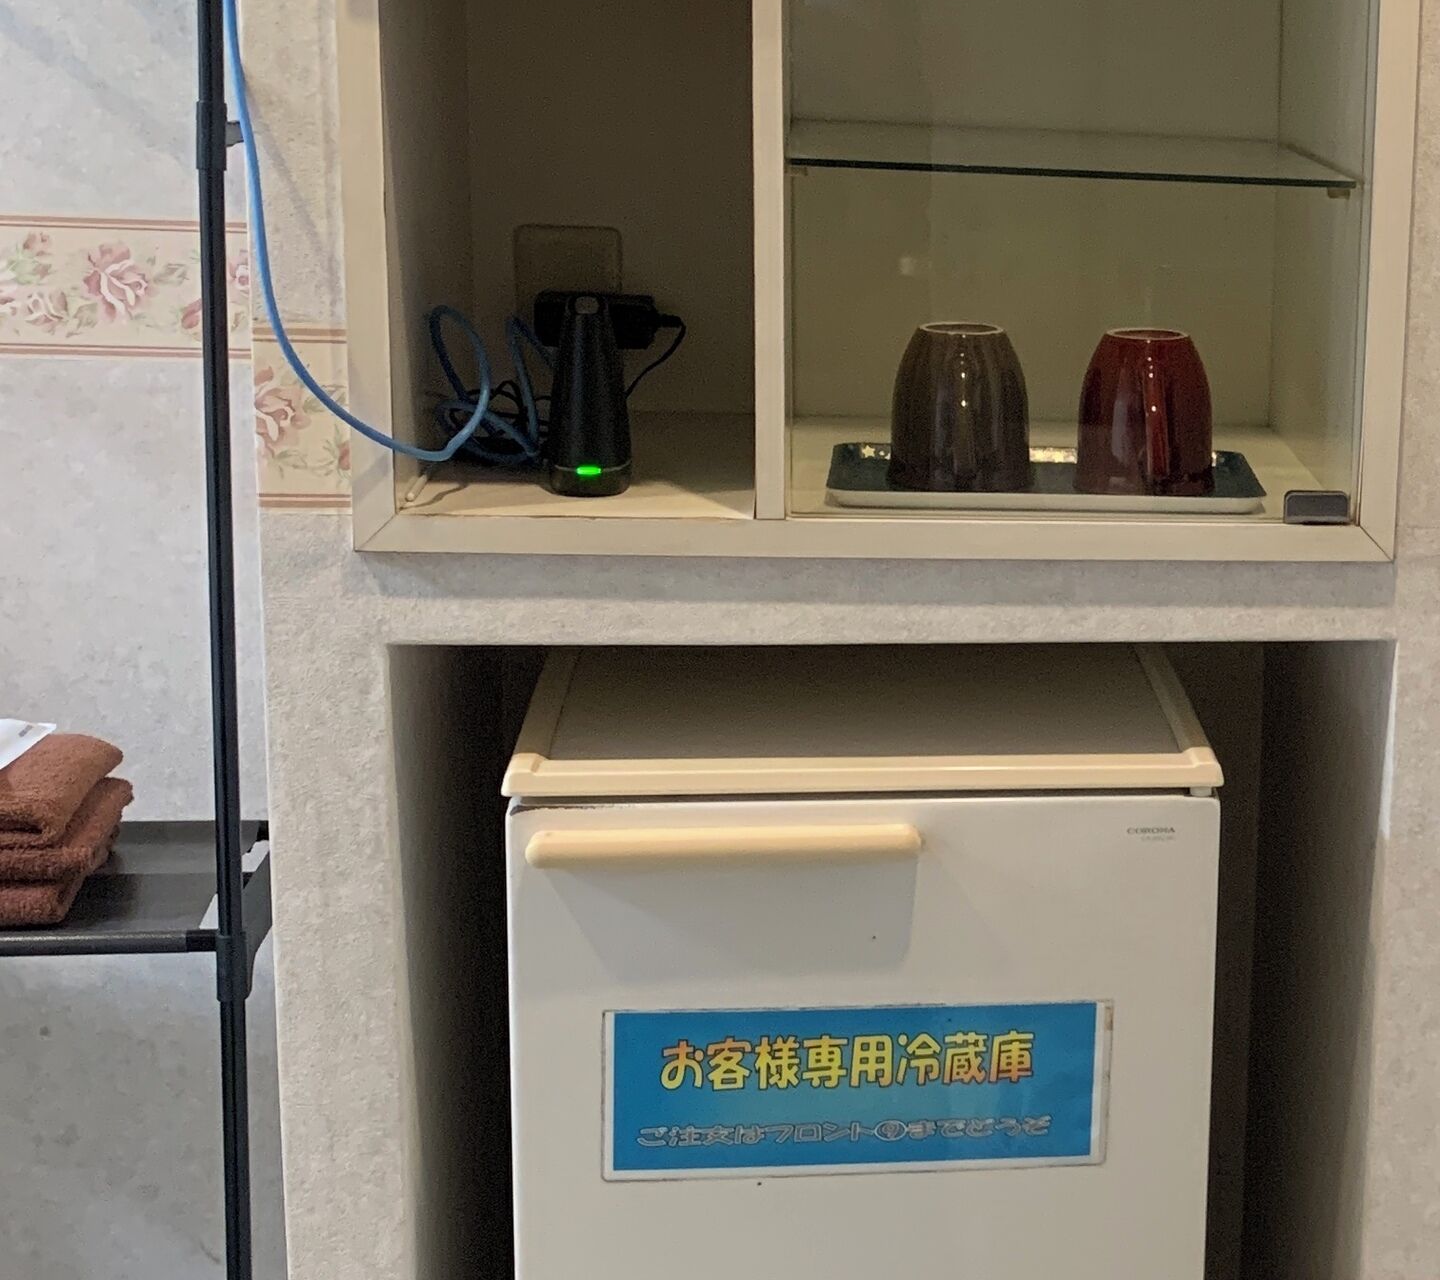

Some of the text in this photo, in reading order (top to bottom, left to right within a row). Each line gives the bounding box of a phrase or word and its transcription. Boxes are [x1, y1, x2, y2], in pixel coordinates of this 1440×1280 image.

[659, 1029, 1036, 1091] お客様専用冷蔵庫
